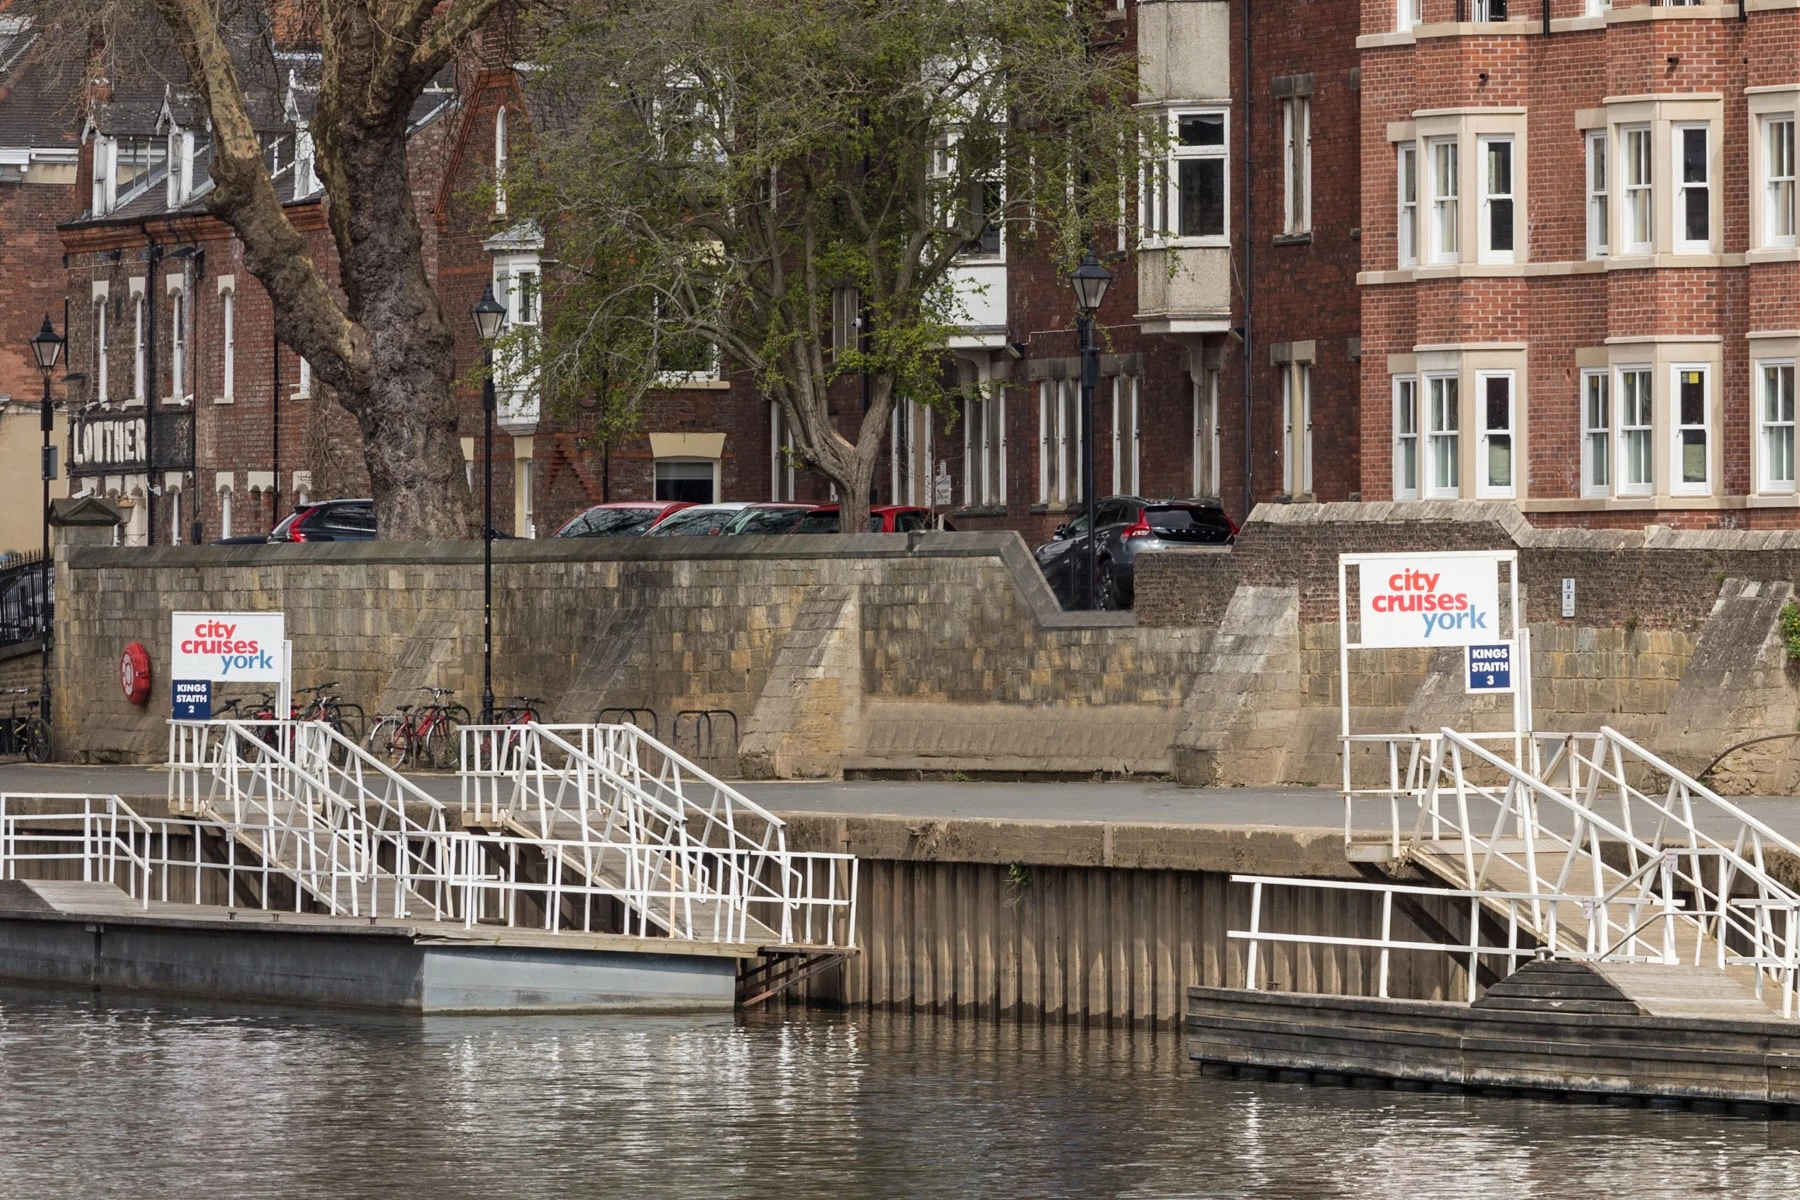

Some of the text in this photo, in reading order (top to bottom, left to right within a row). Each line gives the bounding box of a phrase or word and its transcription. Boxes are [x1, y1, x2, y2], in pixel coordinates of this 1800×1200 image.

[73, 418, 146, 464] LOWTHER
[1388, 568, 1440, 592] city
[1372, 593, 1468, 612] cruises
[1422, 604, 1487, 638] york
[194, 619, 237, 639] city
[181, 640, 258, 654] cruises
[1472, 648, 1508, 659] KINGS
[221, 650, 273, 675] york
[1471, 661, 1508, 672] STAITH
[1486, 675, 1495, 685] 3
[177, 684, 207, 692] KINGS
[176, 694, 207, 703] STAITH
[188, 705, 195, 713] 2
